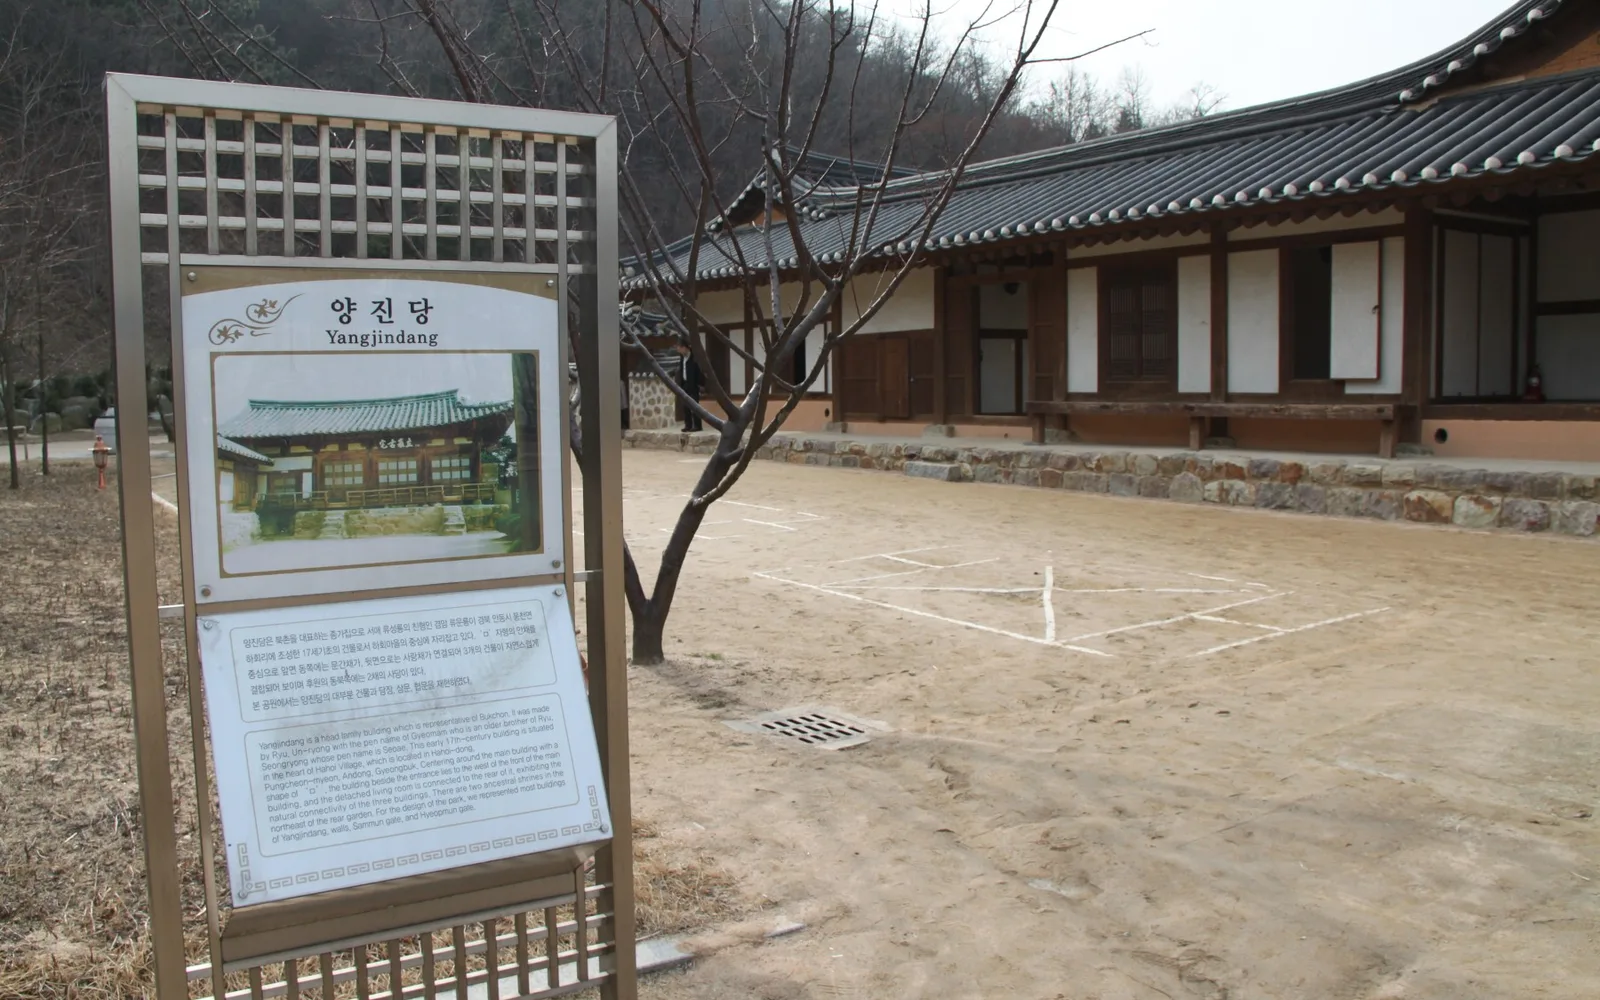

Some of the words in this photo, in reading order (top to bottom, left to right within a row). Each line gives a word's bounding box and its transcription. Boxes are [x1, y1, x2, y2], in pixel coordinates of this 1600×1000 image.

[326, 329, 439, 348] Yangjindang
[243, 636, 273, 648] 양진당은
[275, 633, 297, 645] 북촌을
[298, 631, 328, 642] 대표하는
[366, 626, 381, 635] 서애
[411, 621, 433, 631] 친형인
[477, 615, 490, 624] 경북
[491, 613, 512, 623] 안동시
[245, 651, 276, 663] 하회리에
[277, 649, 300, 660] 조성한
[302, 645, 340, 657] 17세기초의
[341, 642, 371, 653] 건물로서
[371, 638, 408, 650] 하회마을의
[408, 635, 430, 646] 중심에
[431, 633, 459, 644] 자리잡고
[495, 627, 516, 637] 자형의
[247, 667, 279, 679] 중심으로
[298, 661, 329, 674] 동쪽에는
[402, 650, 431, 662] 사랑채가
[433, 647, 462, 659] 연결되어
[462, 645, 482, 655] 3개의
[483, 642, 504, 653] 건물이
[505, 638, 539, 650] 자연스럽게
[250, 682, 280, 695] 결합되어
[281, 680, 304, 690] 보이며
[305, 676, 328, 688] 후원의
[366, 670, 386, 681] 2채의
[386, 668, 409, 679] 사당이
[252, 701, 260, 711] 본
[262, 696, 299, 710] 공원에서는
[300, 692, 331, 705] 양진당의
[331, 690, 354, 701] 대부분
[355, 687, 377, 698] 건물과
[259, 737, 305, 751] Yangjindang
[320, 733, 340, 742] head
[362, 726, 391, 737] building
[392, 723, 413, 732] which
[531, 705, 549, 713] made
[331, 742, 347, 750] with
[349, 740, 362, 748] the
[362, 738, 378, 746] pen
[379, 735, 400, 744] name
[449, 726, 464, 734] who
[483, 720, 501, 730] older
[502, 718, 528, 727] brother
[261, 757, 309, 772] Seongryong
[310, 754, 335, 764] whose
[335, 752, 351, 761] pen
[352, 749, 373, 758] name
[409, 740, 424, 750] This
[425, 739, 444, 748] early
[492, 728, 520, 739] building
[271, 771, 284, 780] the
[284, 768, 305, 778] heart
[365, 757, 387, 766] which
[395, 751, 422, 762] located
[419, 756, 455, 769] Centering
[455, 753, 480, 763] around
[481, 751, 493, 759] the
[493, 749, 510, 757] main
[511, 744, 538, 755] building
[538, 742, 552, 750] with
[266, 792, 289, 802] shape
[328, 783, 341, 792] the
[341, 779, 370, 791] building
[370, 776, 395, 786] beside
[396, 773, 408, 782] the
[408, 769, 440, 780] entrance
[460, 764, 473, 772] the
[473, 762, 489, 770] west
[497, 758, 509, 766] the
[509, 756, 525, 764] front
[532, 753, 544, 761] the
[544, 751, 560, 759] main
[303, 797, 319, 806] and
[320, 795, 333, 804] the
[334, 789, 371, 802] detached
[372, 786, 393, 797] living
[393, 783, 413, 792] room
[422, 776, 462, 788] connected
[470, 772, 483, 780] the
[550, 760, 561, 768] the
[268, 811, 297, 822] natural
[298, 804, 347, 818] connectivity
[357, 799, 371, 808] the
[371, 797, 392, 806] three
[432, 786, 454, 796] There
[468, 782, 482, 790] two
[483, 777, 517, 788] ancestral
[517, 773, 543, 783] shrines
[552, 769, 564, 777] the
[270, 820, 306, 833] northeast
[315, 817, 328, 825] the
[329, 815, 344, 823] rear
[375, 806, 387, 816] For
[388, 805, 401, 814] the
[401, 801, 426, 812] design
[435, 798, 447, 806] the
[478, 787, 519, 799] represented
[519, 784, 536, 792] most
[536, 778, 565, 790] buildings
[352, 817, 384, 830] Sammun
[404, 812, 419, 821] and
